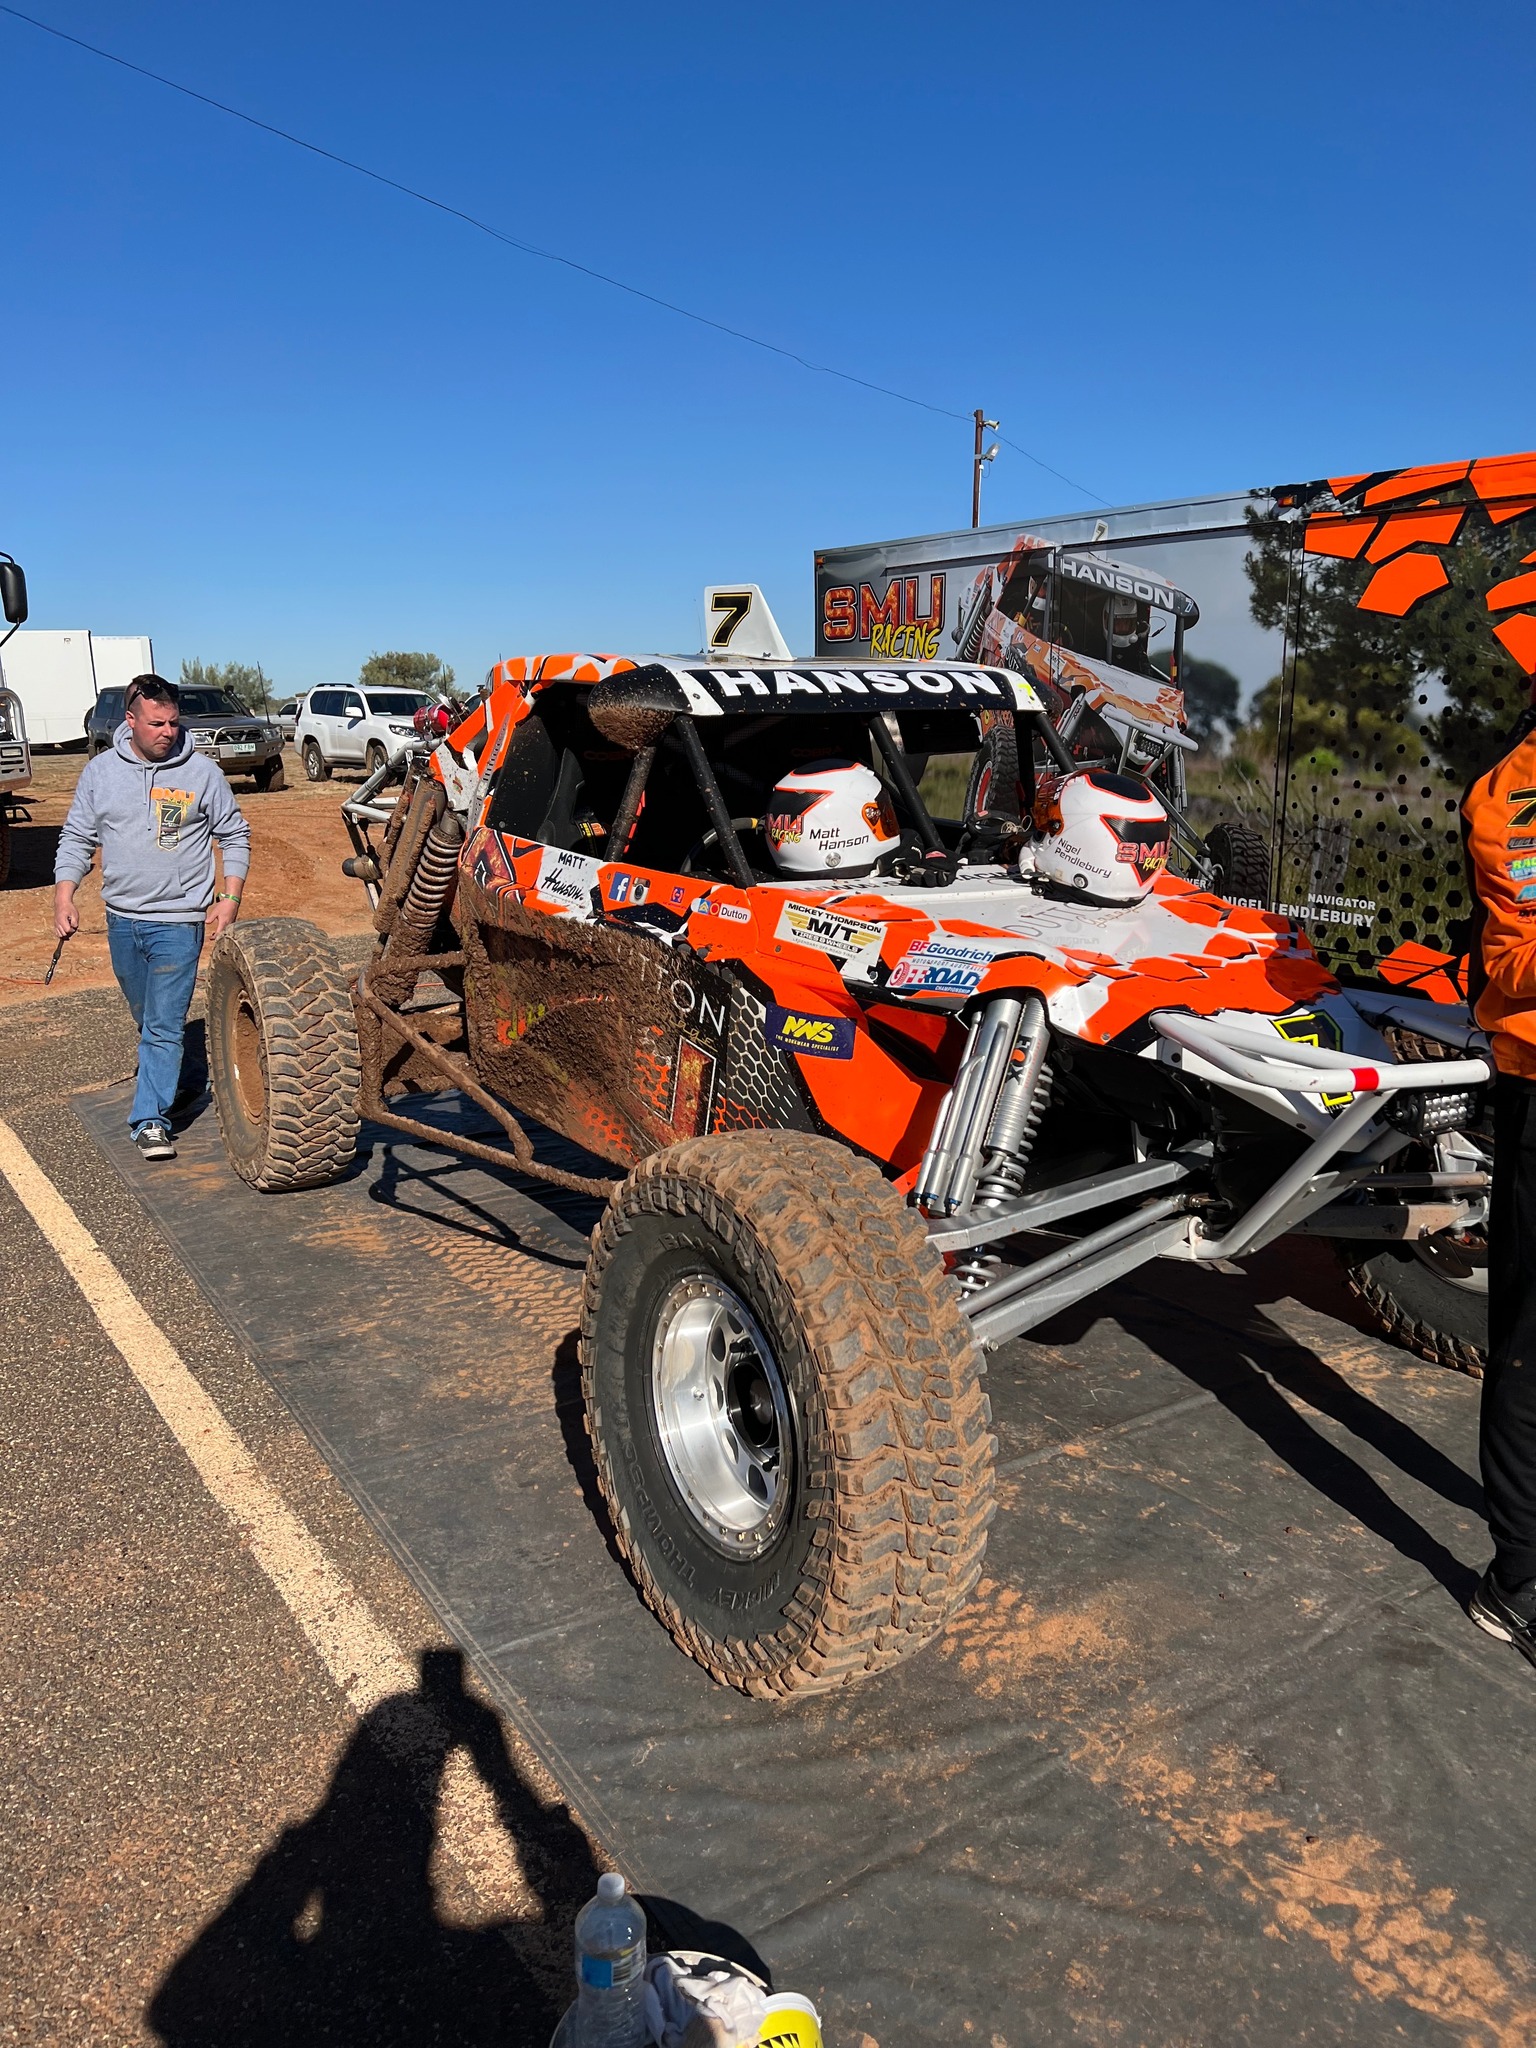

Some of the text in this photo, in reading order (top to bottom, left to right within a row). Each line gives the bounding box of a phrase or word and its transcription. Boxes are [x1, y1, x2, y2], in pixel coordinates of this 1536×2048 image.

[1060, 558, 1174, 610] HANSON
[823, 572, 947, 642] SMU
[711, 591, 753, 647] 7
[870, 623, 942, 660] RACING
[709, 670, 1002, 697] HANSON
[160, 804, 183, 823] 7
[1506, 787, 1536, 828] 7
[809, 828, 841, 840] Matt
[818, 835, 870, 851] Hanson
[1058, 838, 1082, 856] Nigel
[557, 852, 586, 869] MATT
[1054, 847, 1112, 878] Pendlebury
[1307, 892, 1377, 911] NAVIGATOR
[721, 907, 748, 921] Dutton
[788, 903, 882, 934] MICKEY THOMPSON
[806, 917, 859, 942] M/T
[826, 938, 859, 953] WHEELS
[909, 940, 994, 962] BFGoodrich
[912, 958, 985, 972] MOTORSPORT AUSTRALIA
[811, 1043, 840, 1052] SPECIALIST
